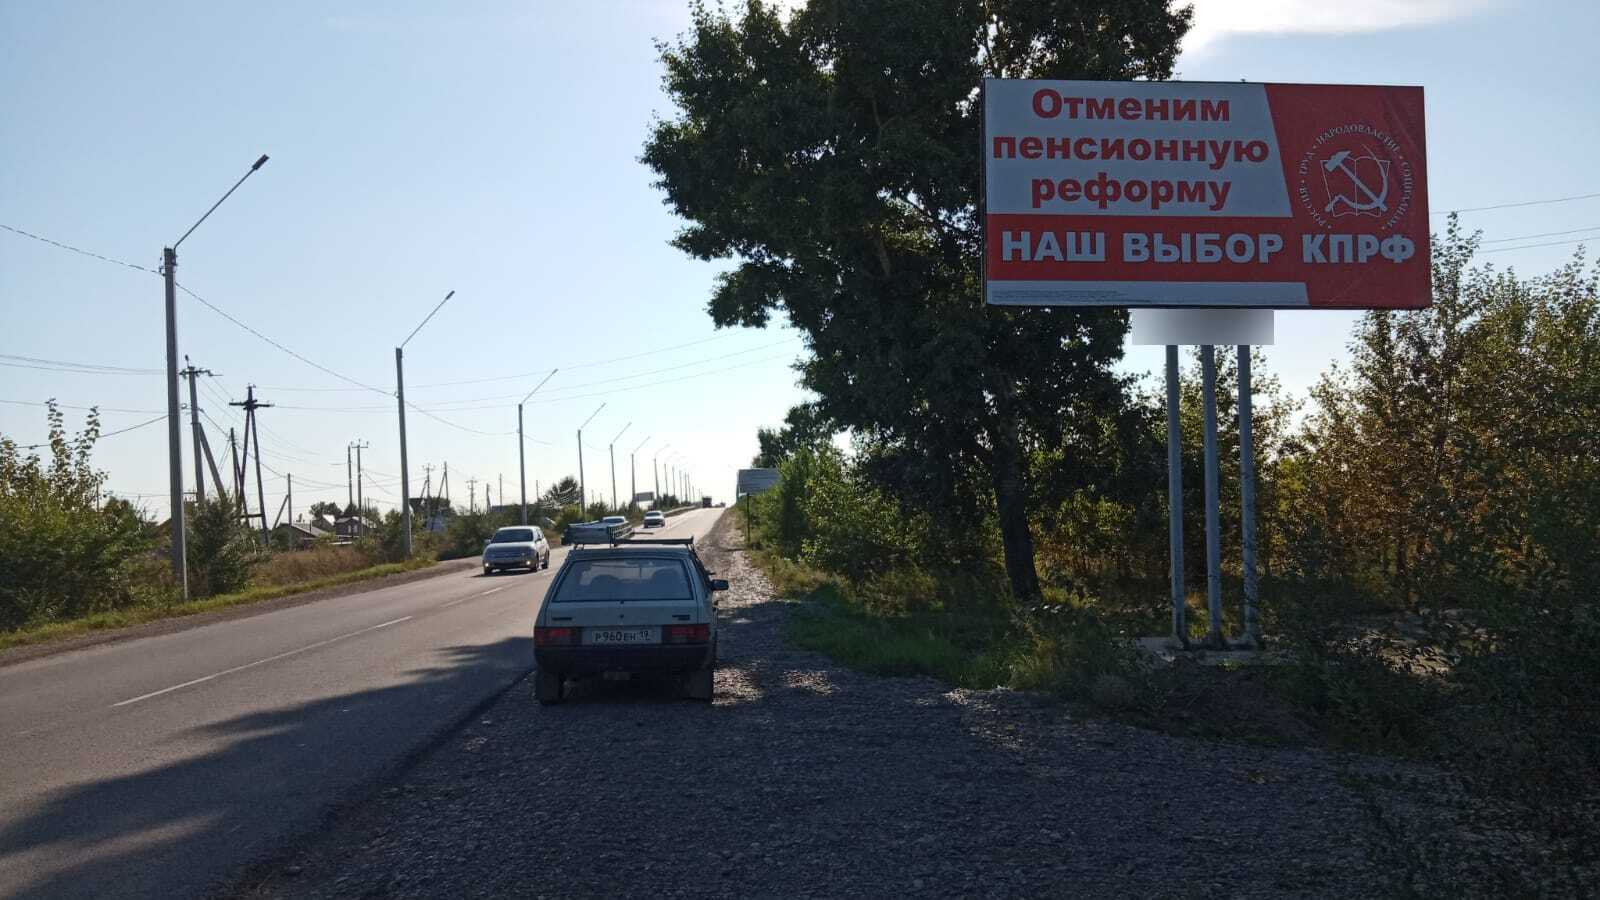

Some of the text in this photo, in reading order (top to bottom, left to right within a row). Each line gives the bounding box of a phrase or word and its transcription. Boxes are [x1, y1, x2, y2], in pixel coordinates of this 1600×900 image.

[1032, 89, 1230, 122] Отменим
[993, 136, 1269, 170] пенсионную
[1031, 172, 1231, 210] реформу
[1001, 230, 1416, 265] НАШ ВЫБОР КПРФ
